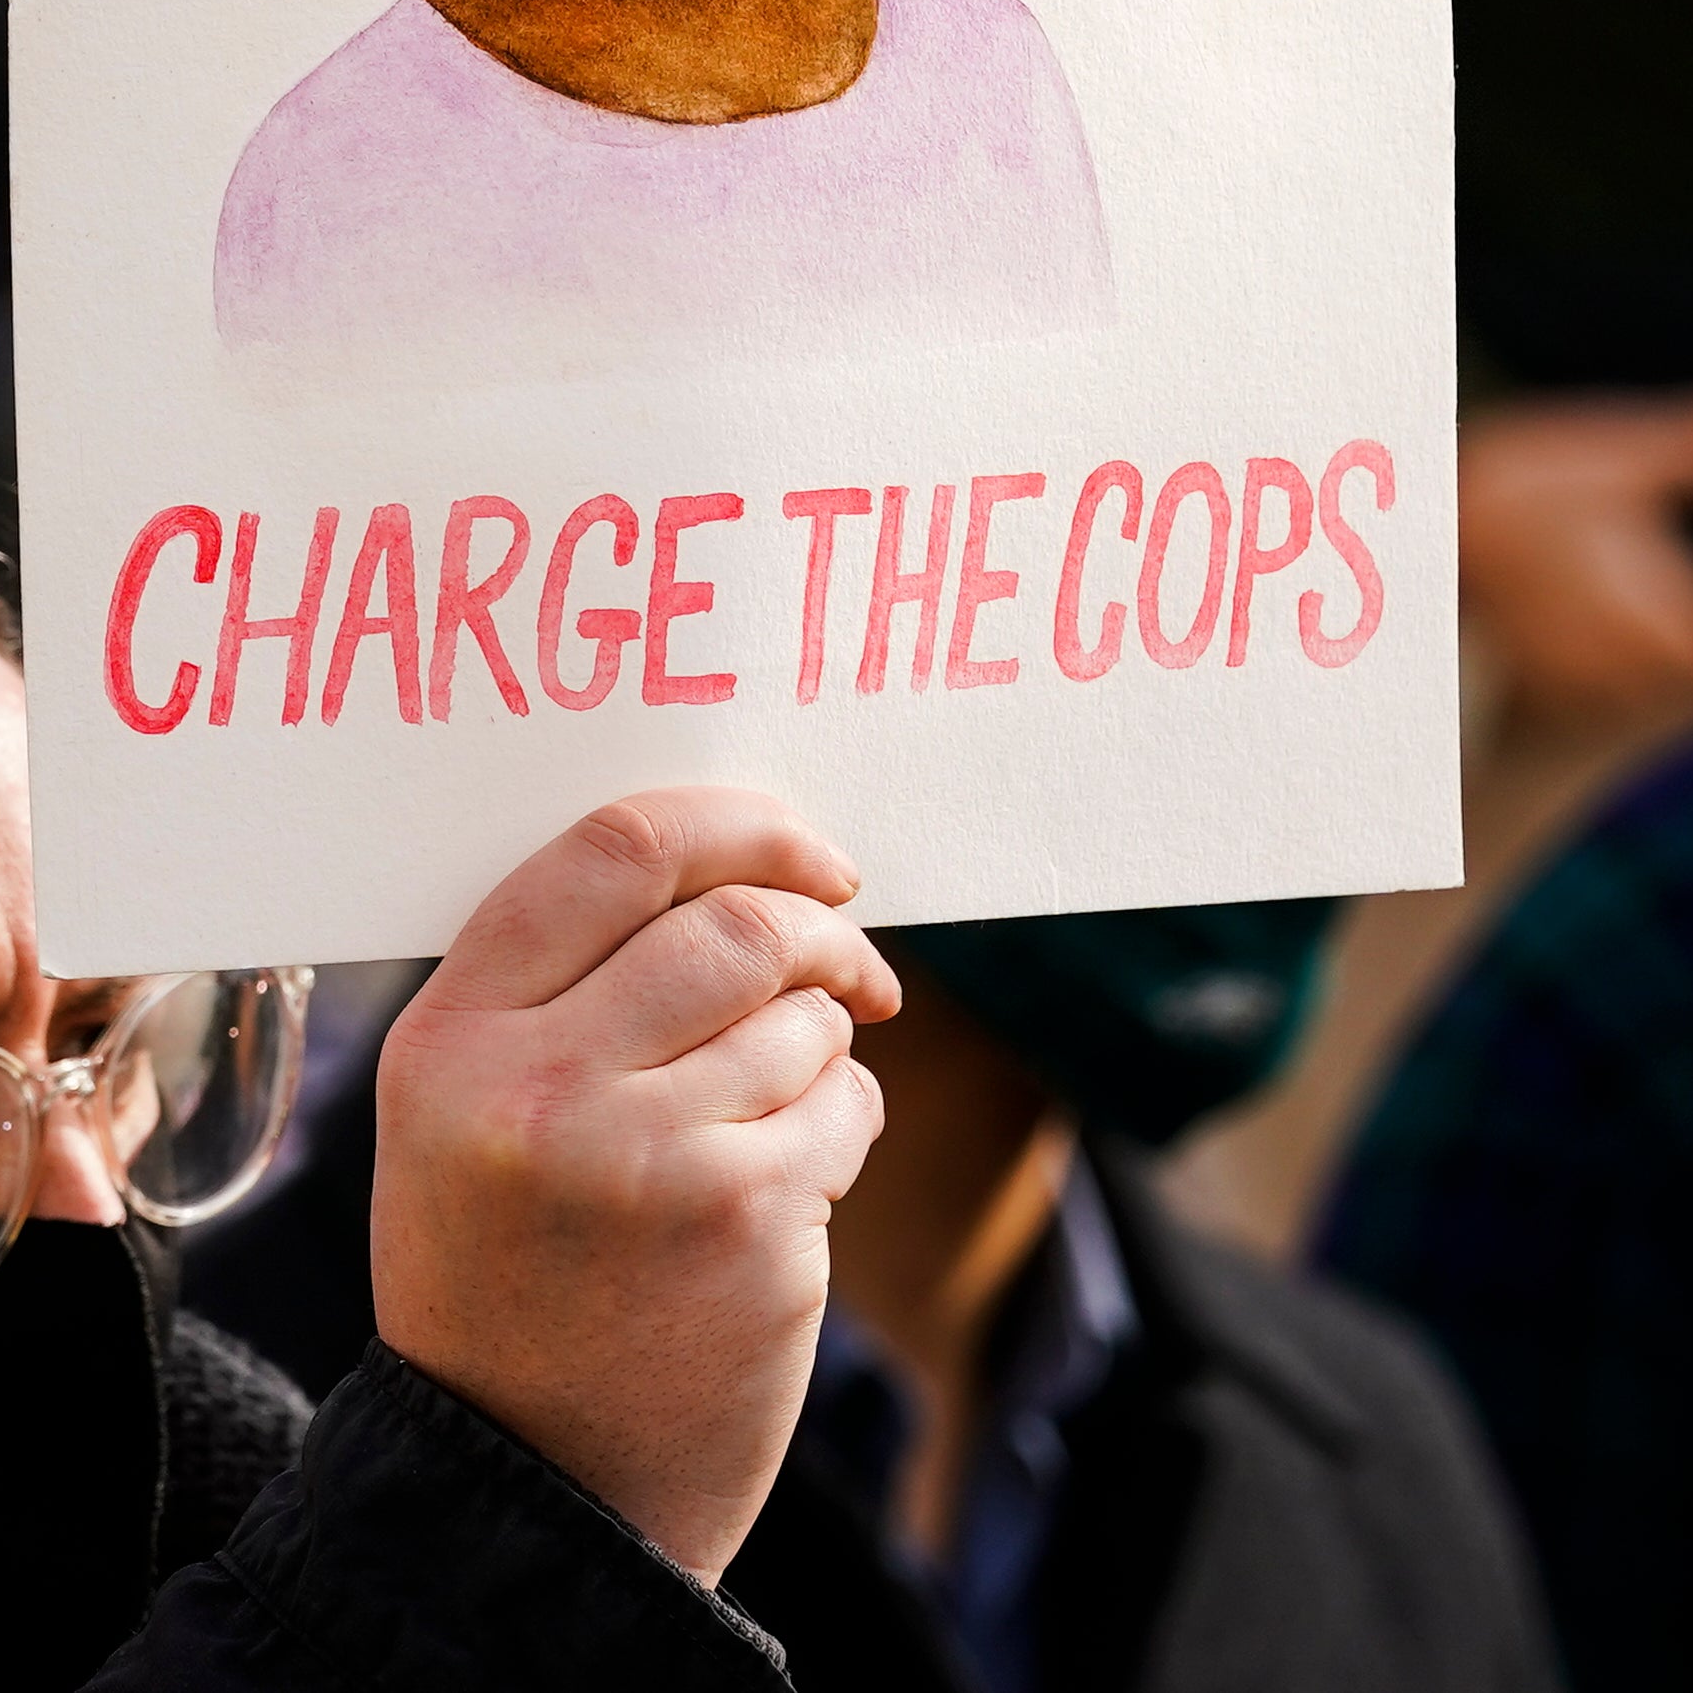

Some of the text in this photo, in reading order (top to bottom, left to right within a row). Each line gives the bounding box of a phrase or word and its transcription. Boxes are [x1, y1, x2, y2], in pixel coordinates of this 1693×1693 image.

[103, 439, 1396, 735] CHARGE THE COPS
